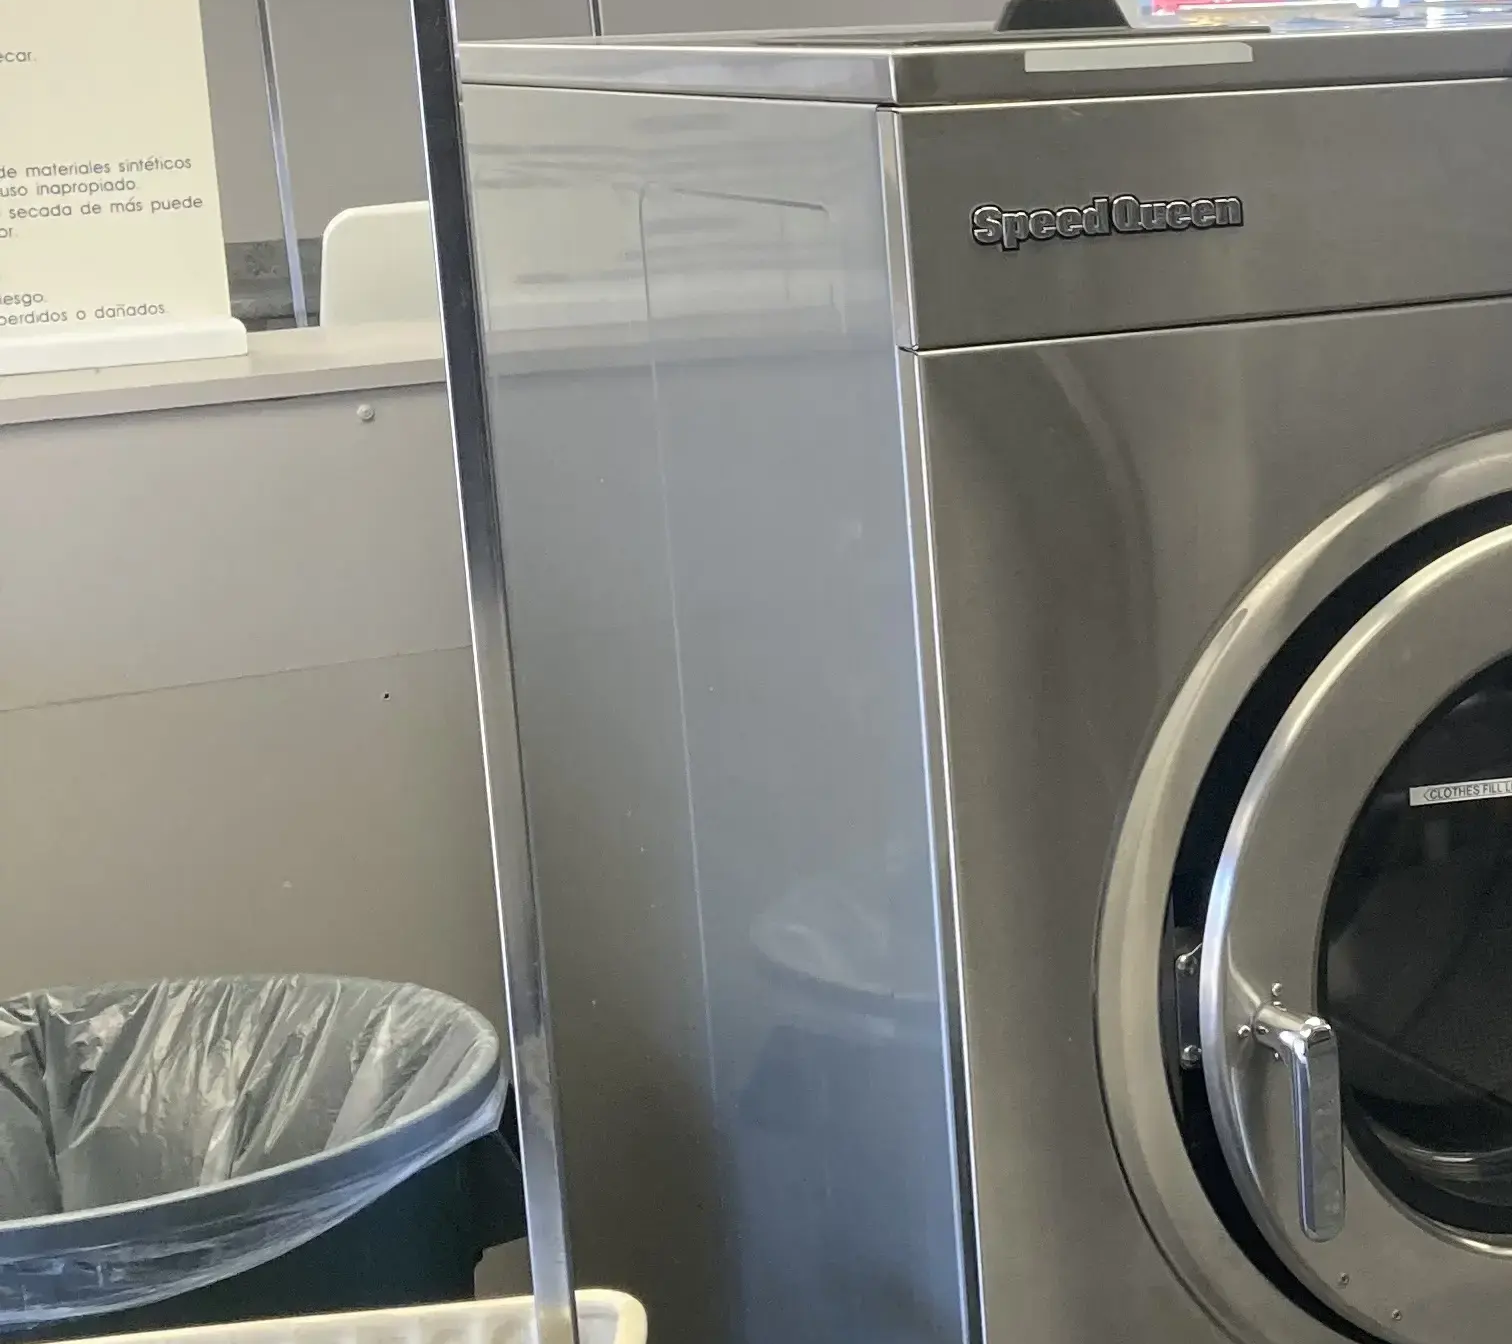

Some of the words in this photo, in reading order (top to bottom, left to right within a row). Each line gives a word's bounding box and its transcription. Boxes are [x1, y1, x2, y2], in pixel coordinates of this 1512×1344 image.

[26, 160, 111, 178] materiales
[118, 155, 192, 173] sintéticos
[9, 203, 73, 220] secada
[80, 202, 102, 216] de
[110, 196, 144, 214] más
[151, 195, 204, 214] puede
[76, 310, 86, 321] o
[1430, 783, 1480, 800] CLOTHES
[1482, 782, 1503, 796] FILL
